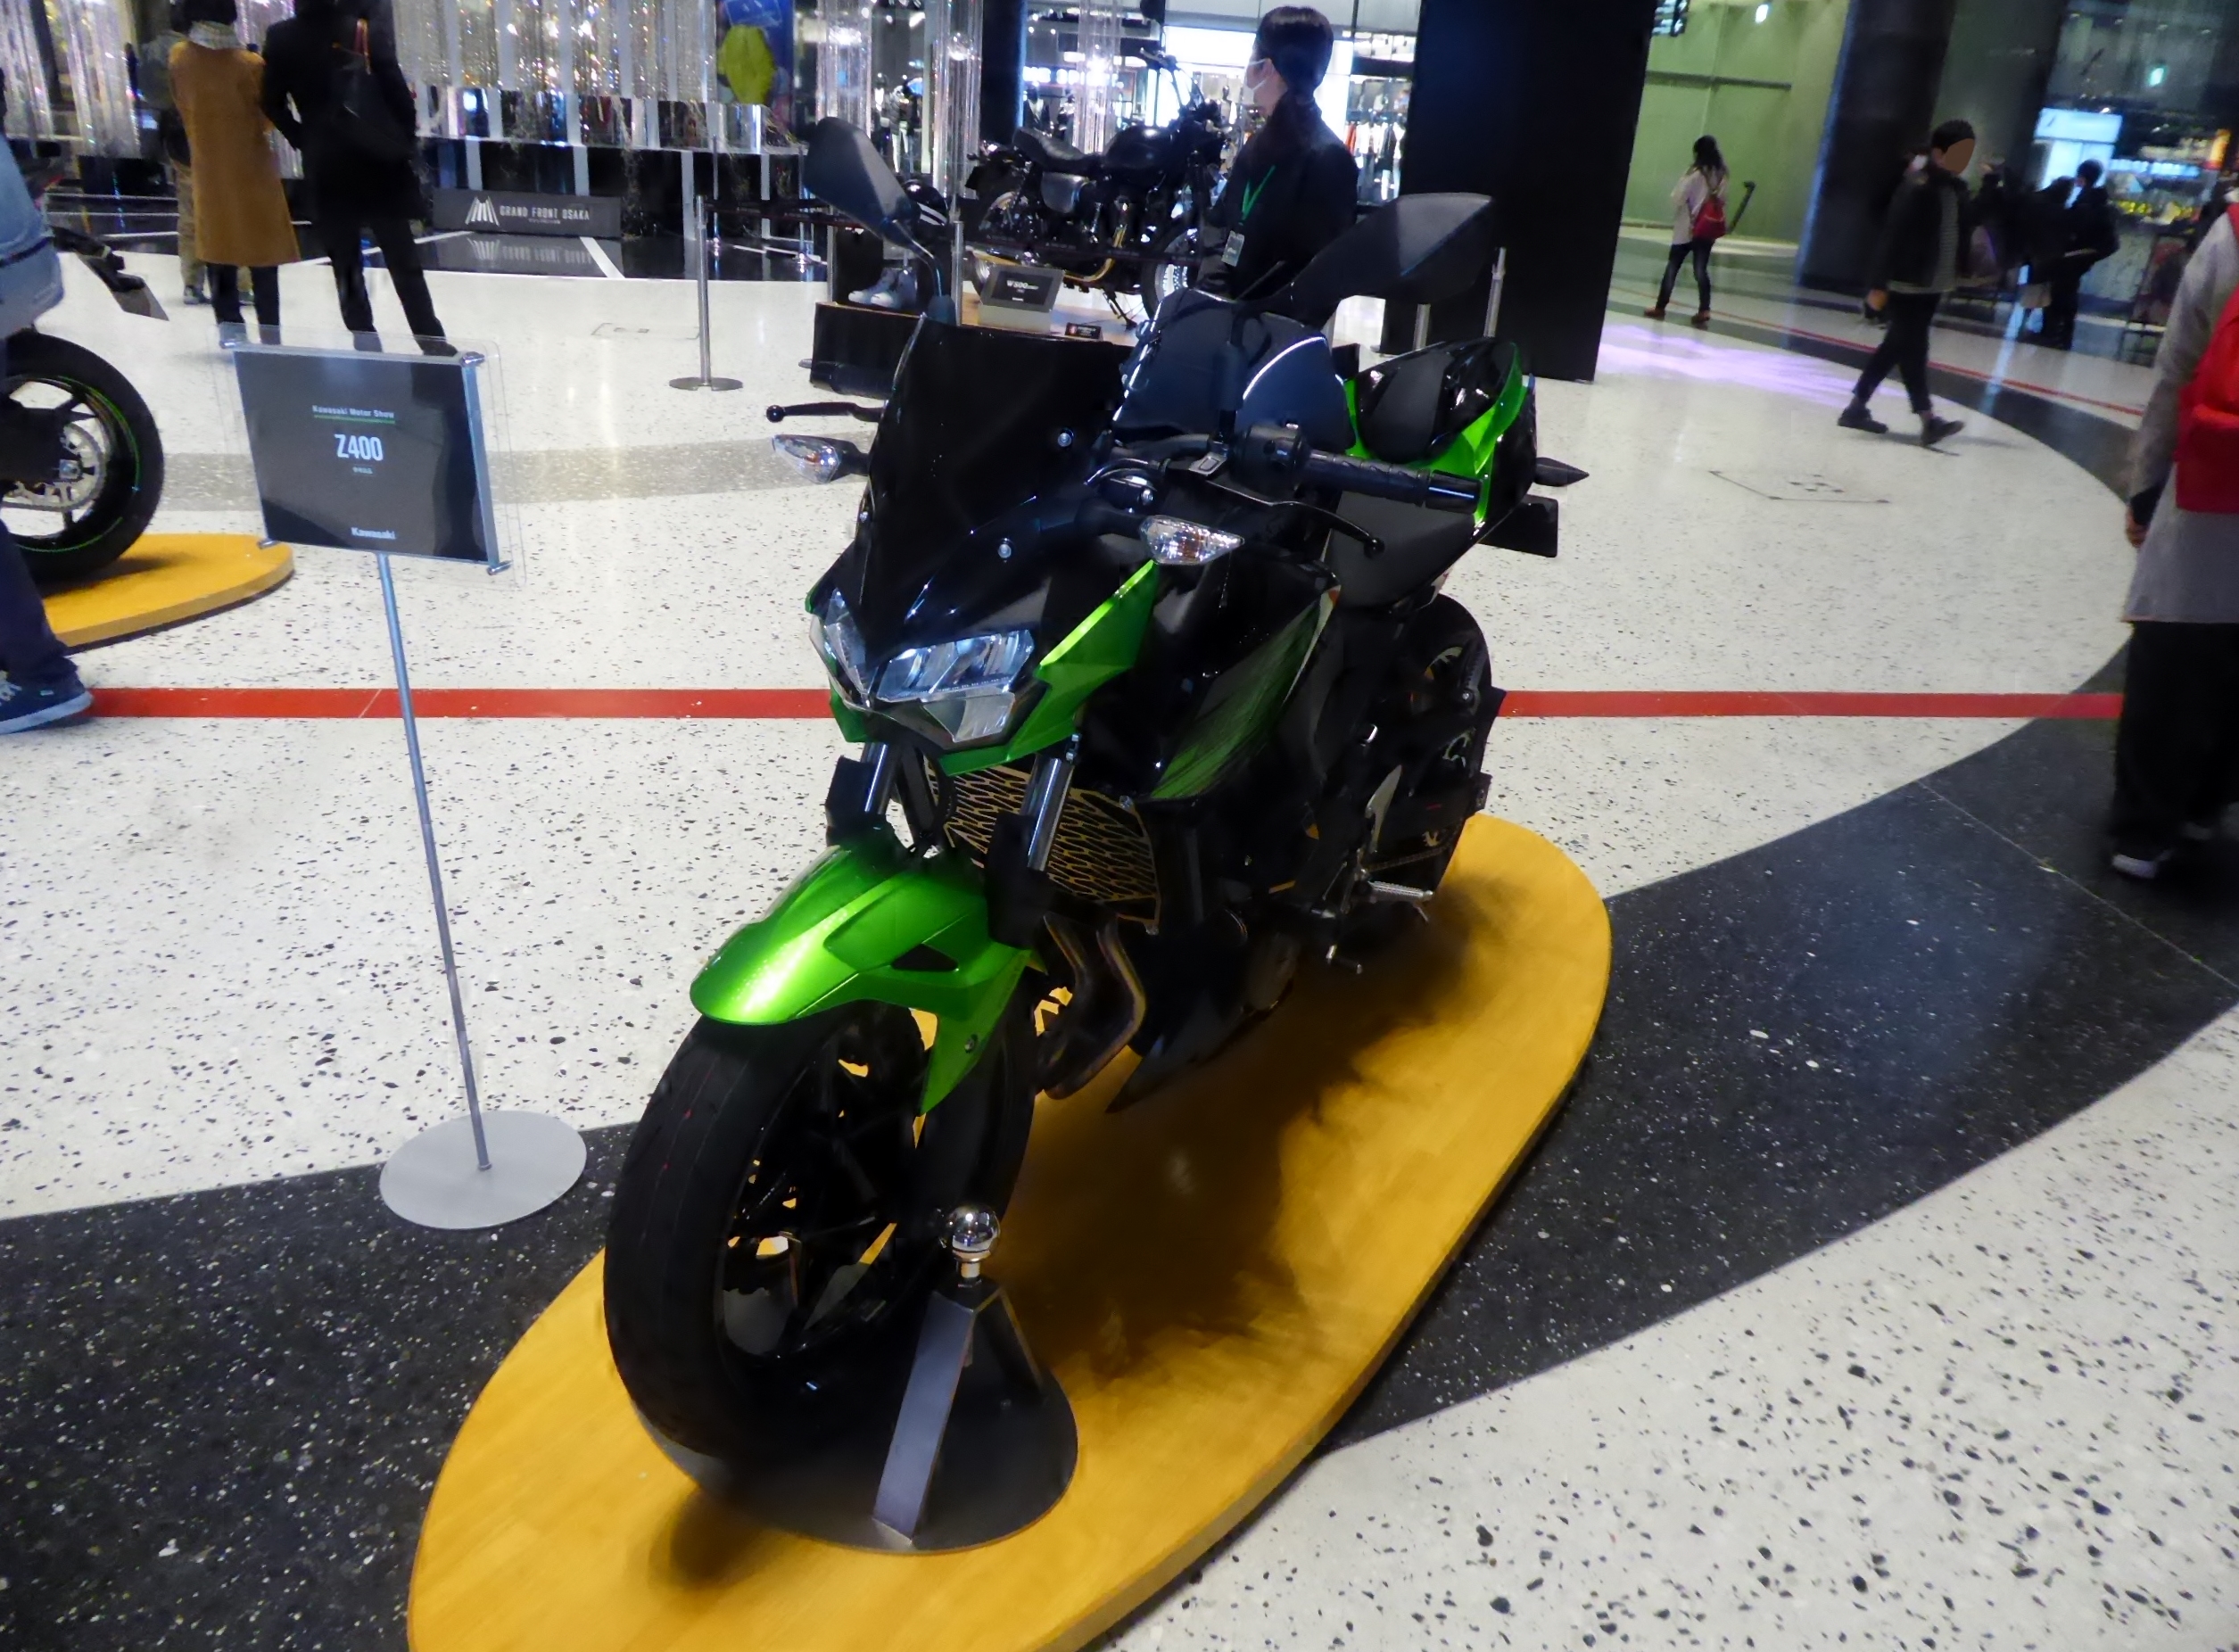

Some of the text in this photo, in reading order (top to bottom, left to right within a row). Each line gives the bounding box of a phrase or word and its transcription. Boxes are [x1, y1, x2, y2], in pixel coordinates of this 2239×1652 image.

[500, 205, 590, 220] GRAND FRONT OSAKA
[311, 404, 394, 418] Kawasaki Motor Show
[334, 434, 384, 461] Z400
[351, 526, 396, 540] Kawasaki
